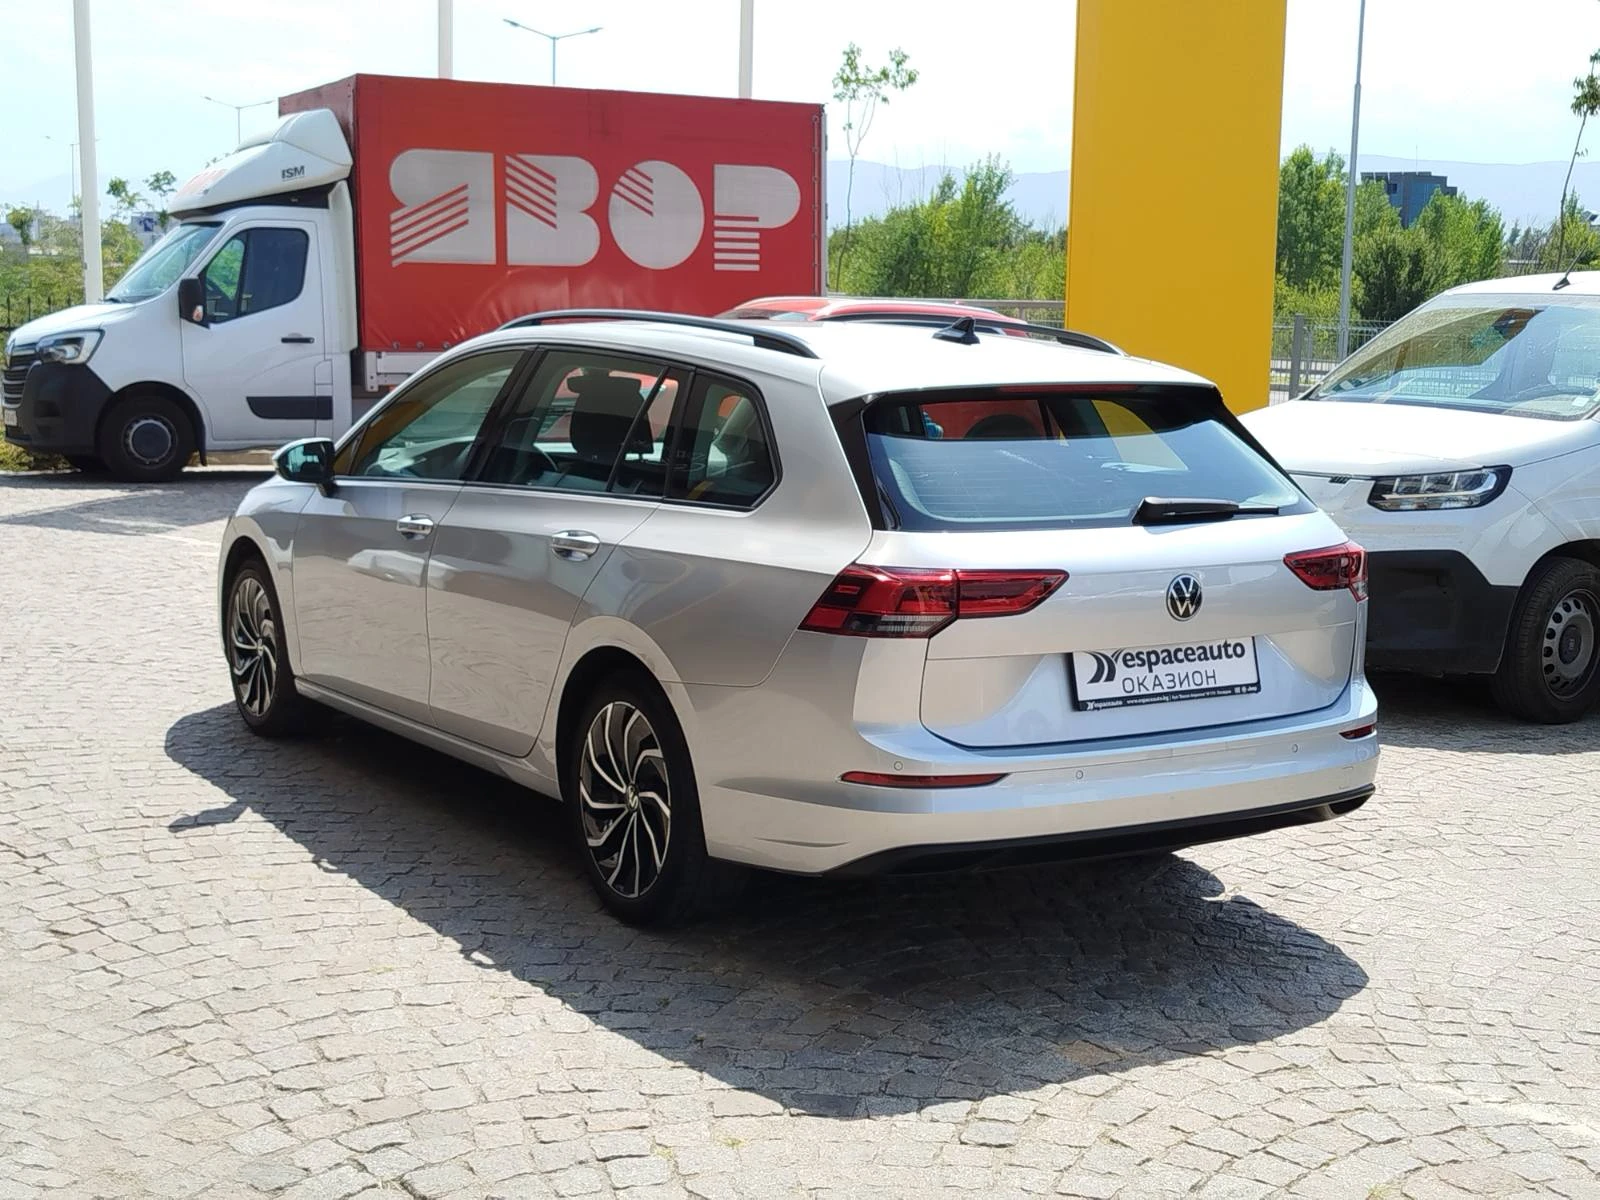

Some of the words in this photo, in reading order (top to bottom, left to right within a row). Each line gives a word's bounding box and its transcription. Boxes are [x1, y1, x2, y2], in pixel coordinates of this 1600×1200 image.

[281, 165, 305, 180] ISM
[389, 148, 800, 271] ЯВОР
[1122, 639, 1246, 673] espaceauto
[1121, 668, 1217, 694] ОКАЗИОН
